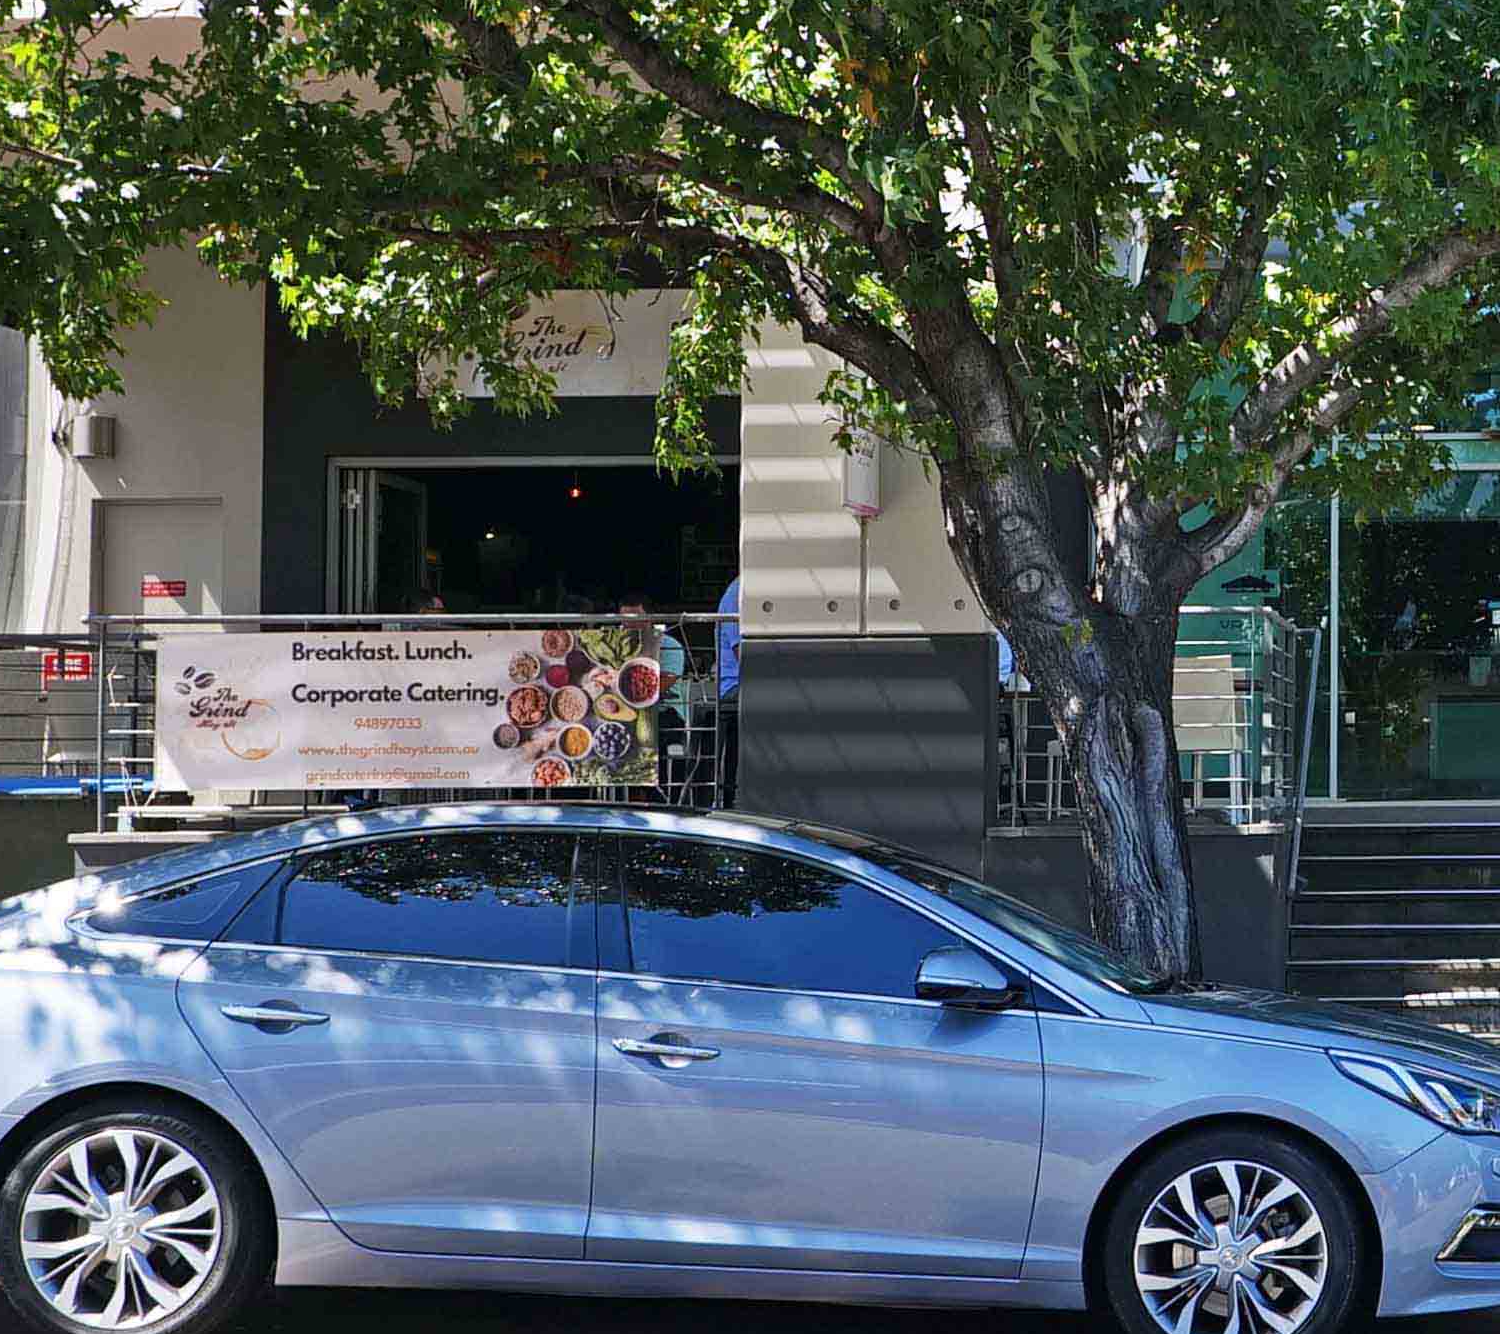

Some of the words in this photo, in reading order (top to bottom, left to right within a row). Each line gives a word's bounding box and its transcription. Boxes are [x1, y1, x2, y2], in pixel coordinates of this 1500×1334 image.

[292, 641, 399, 661] Breakfast.
[405, 640, 473, 660] Lunch.
[291, 683, 402, 708] Corporate
[407, 682, 505, 706] Catering.
[189, 696, 252, 718] Grind
